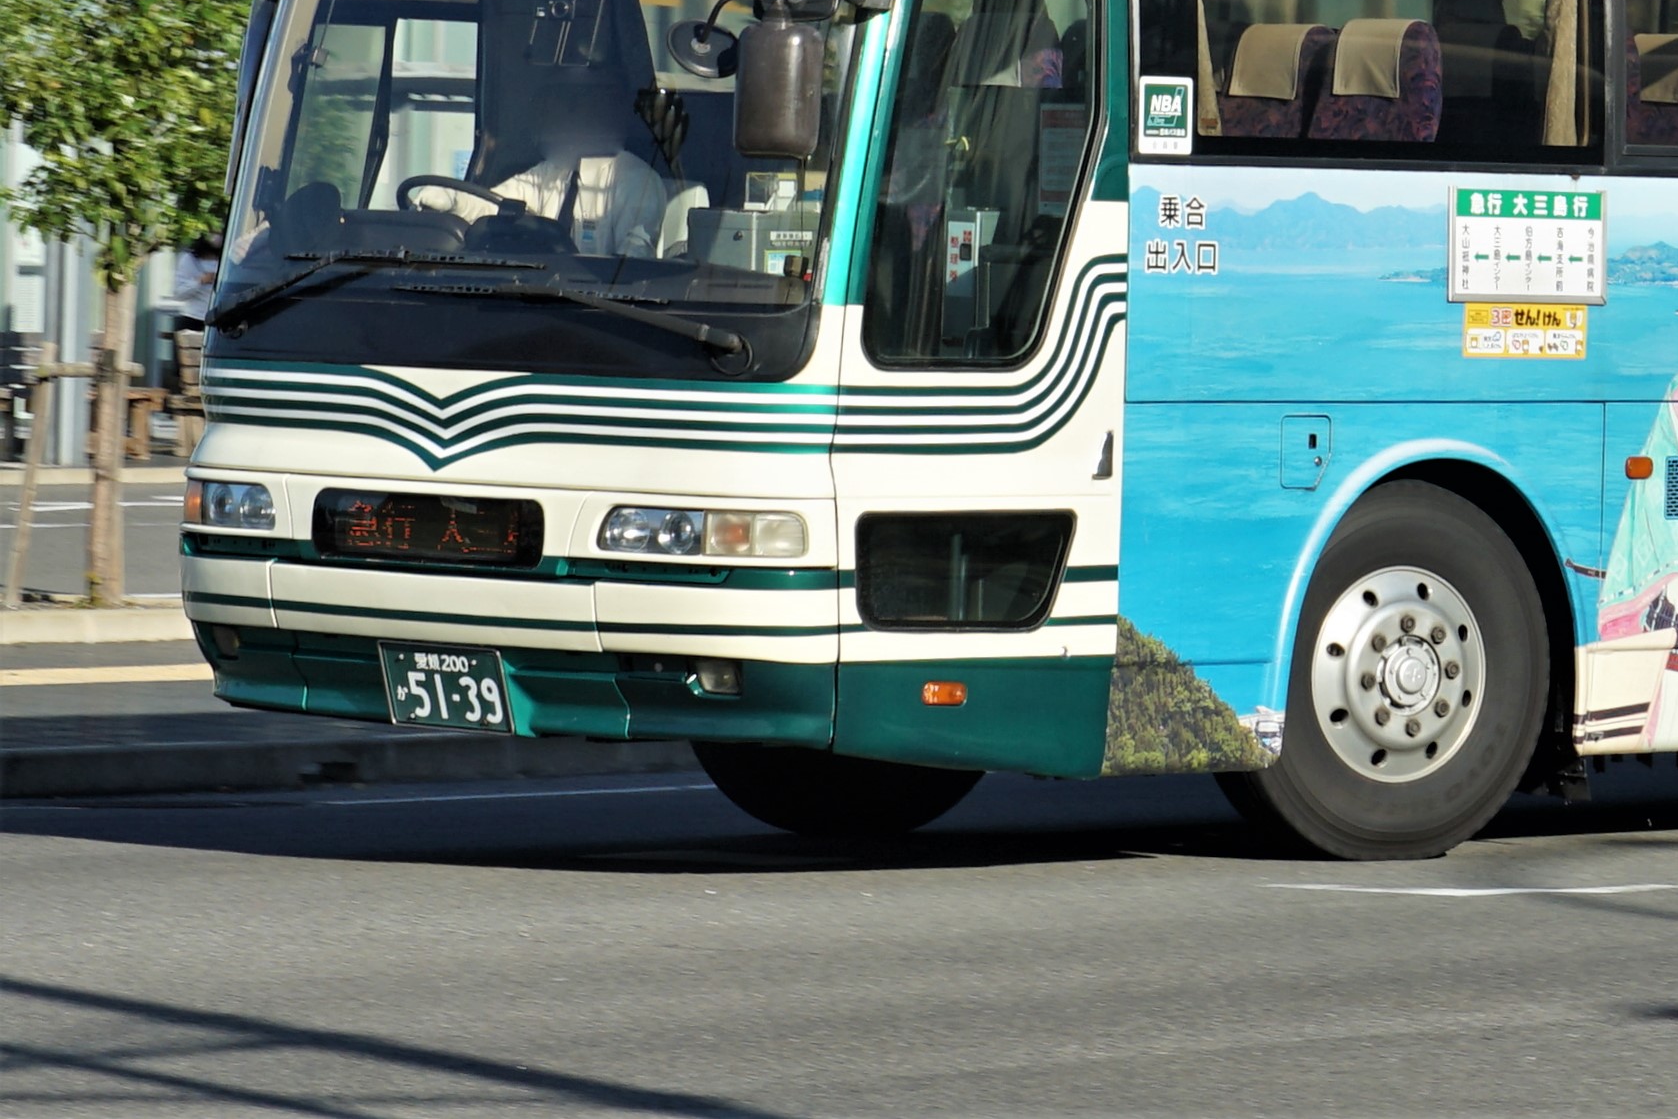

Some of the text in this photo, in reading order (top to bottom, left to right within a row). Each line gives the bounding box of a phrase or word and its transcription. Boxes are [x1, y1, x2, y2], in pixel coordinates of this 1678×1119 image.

[1149, 94, 1182, 112] NBA
[1160, 196, 1205, 227] 乗合
[1470, 192, 1588, 218] 急行 大三島行
[1146, 240, 1217, 273] 出入口
[407, 671, 503, 724] 51-39
